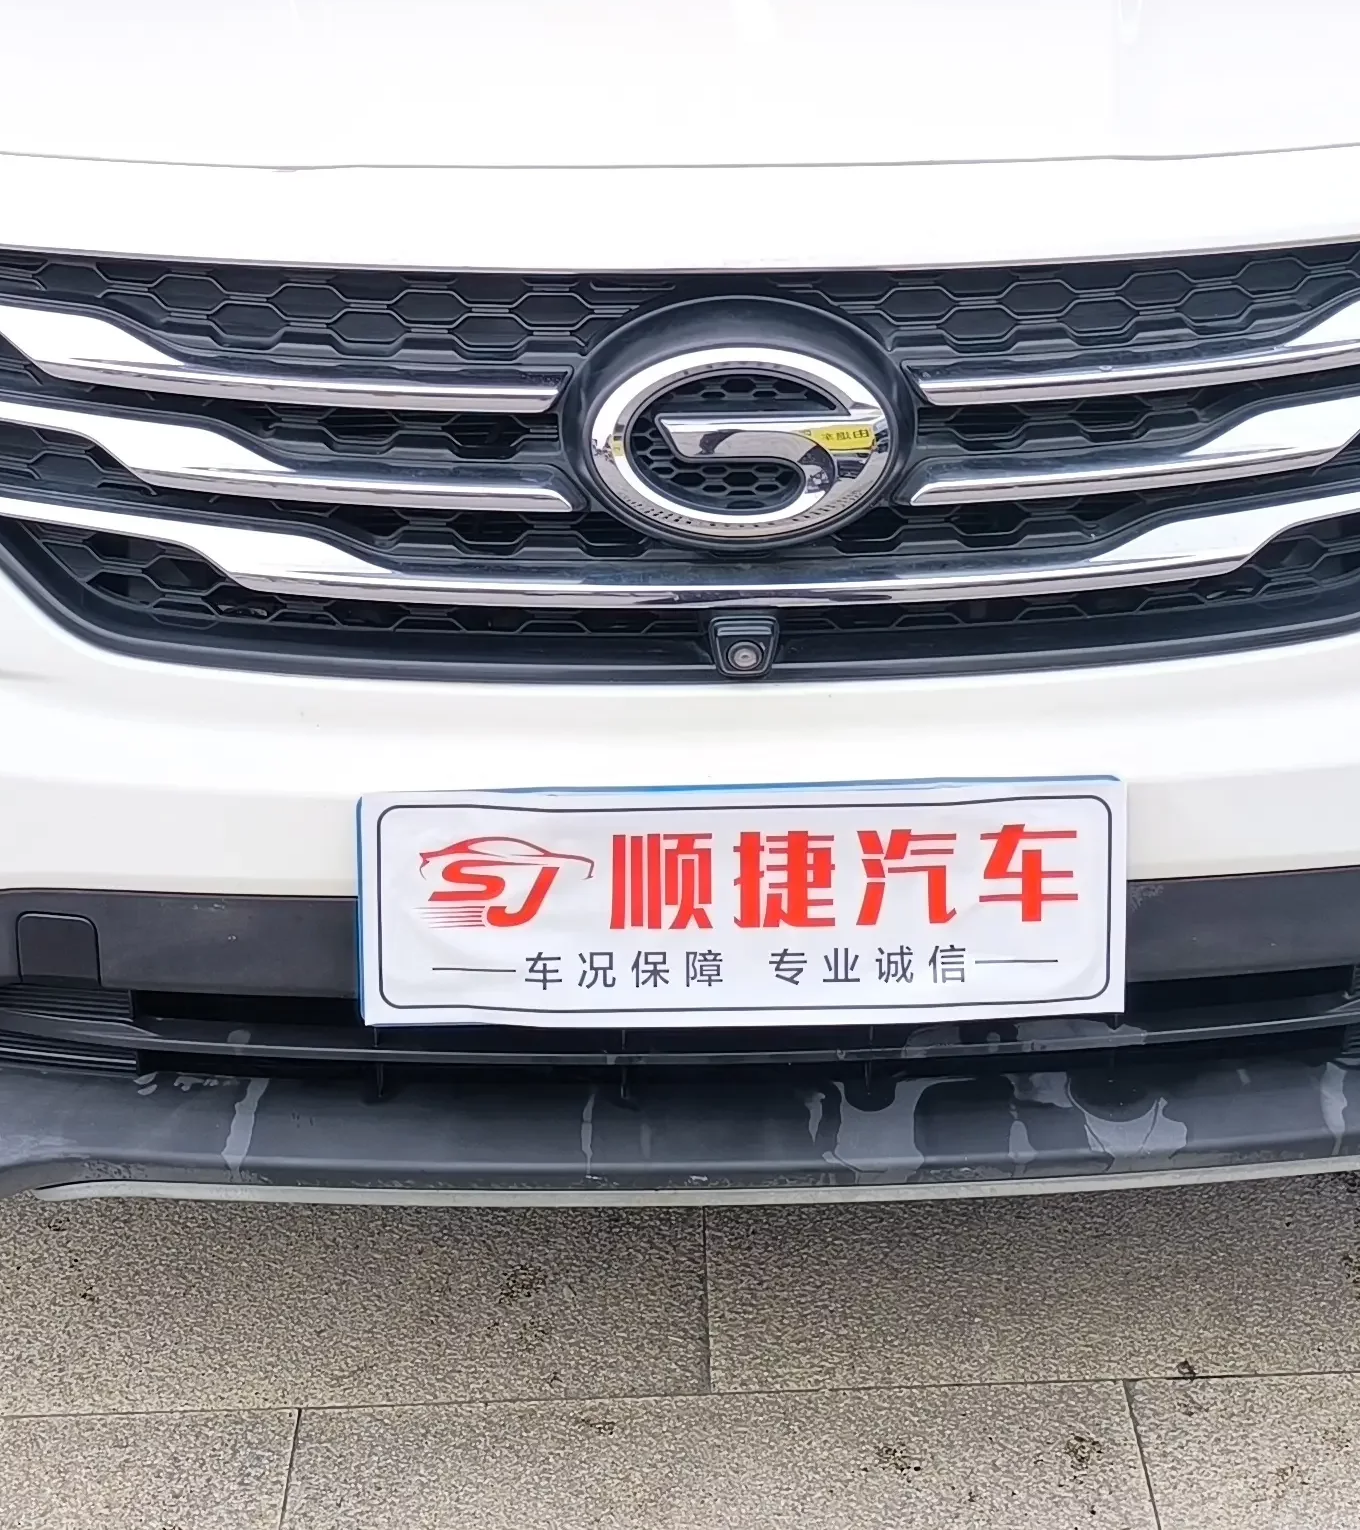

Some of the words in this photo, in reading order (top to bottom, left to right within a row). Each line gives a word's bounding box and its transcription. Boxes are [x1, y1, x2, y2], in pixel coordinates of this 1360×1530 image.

[609, 823, 1079, 930] 顺捷汽车
[524, 949, 723, 990] 车况保障
[769, 945, 966, 986] 专业诚信
